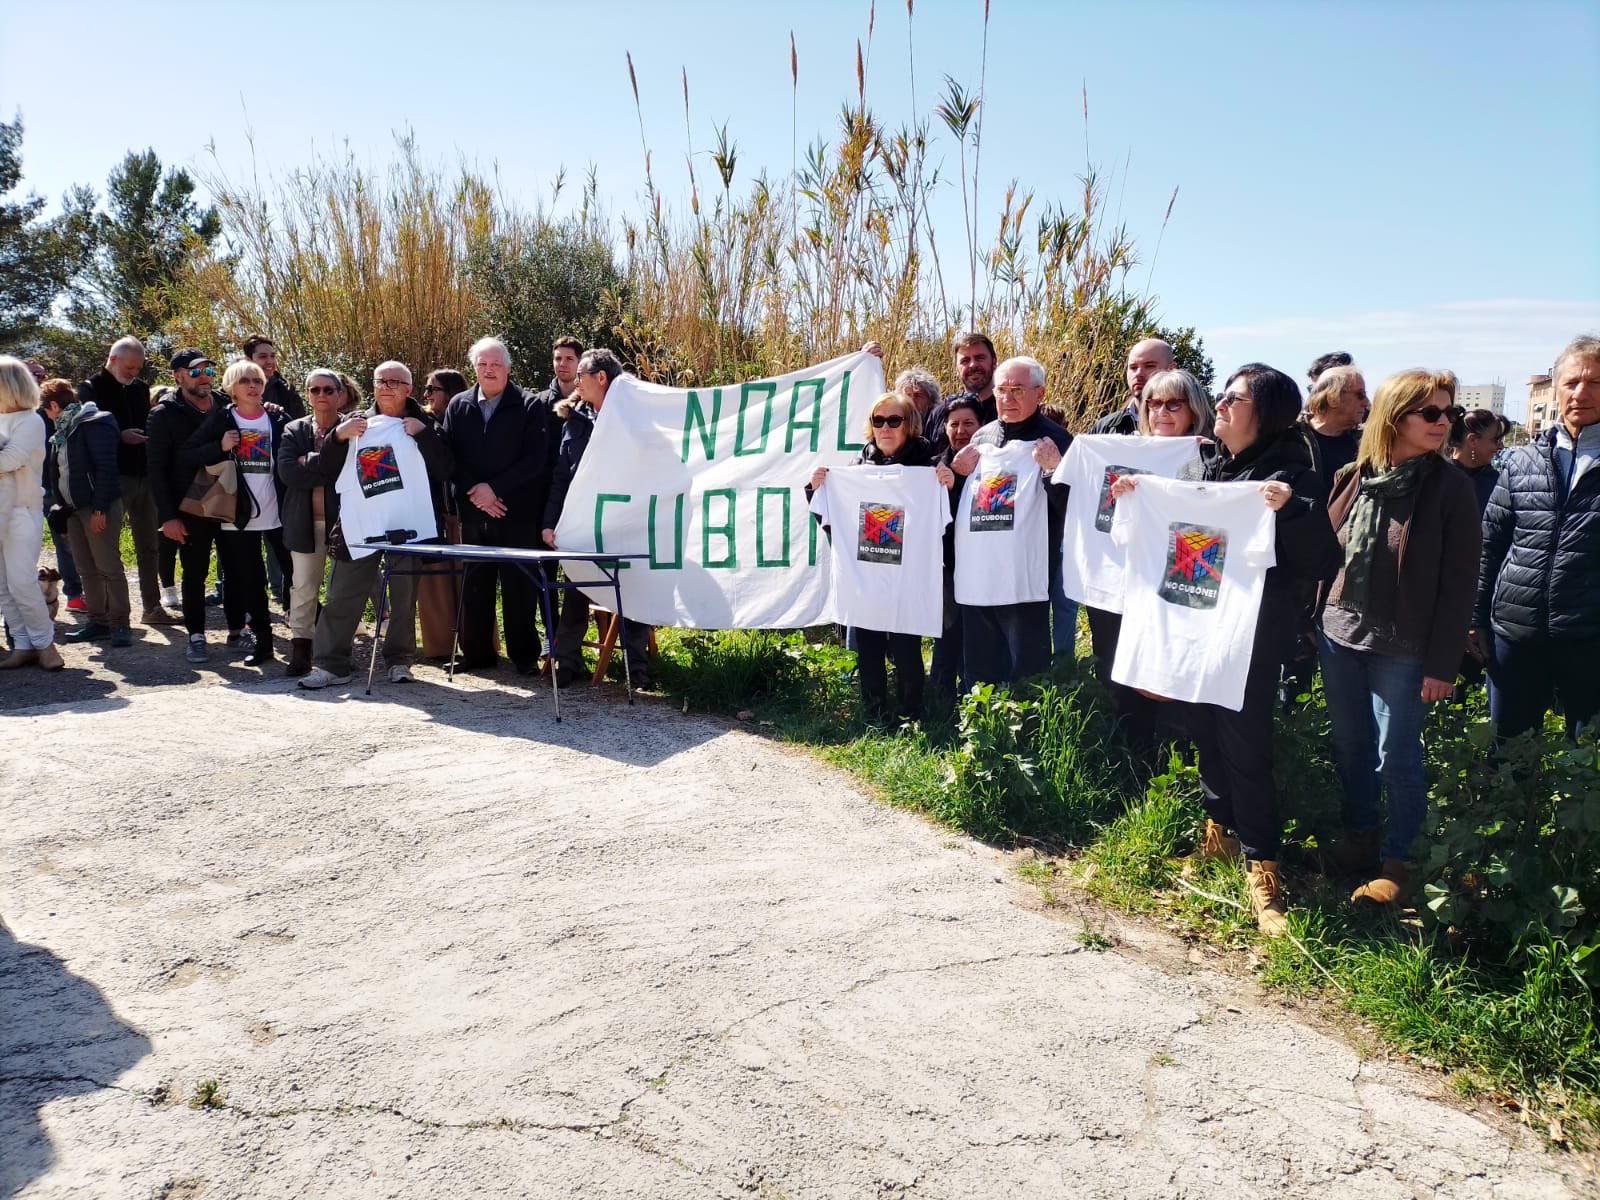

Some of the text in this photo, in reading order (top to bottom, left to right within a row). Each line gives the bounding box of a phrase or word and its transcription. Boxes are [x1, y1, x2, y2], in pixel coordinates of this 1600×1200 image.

[362, 483, 373, 491] NO
[1098, 513, 1110, 522] NO
[859, 545, 901, 555] NO CUBONE!
[1165, 580, 1217, 599] NO CUBONE!
